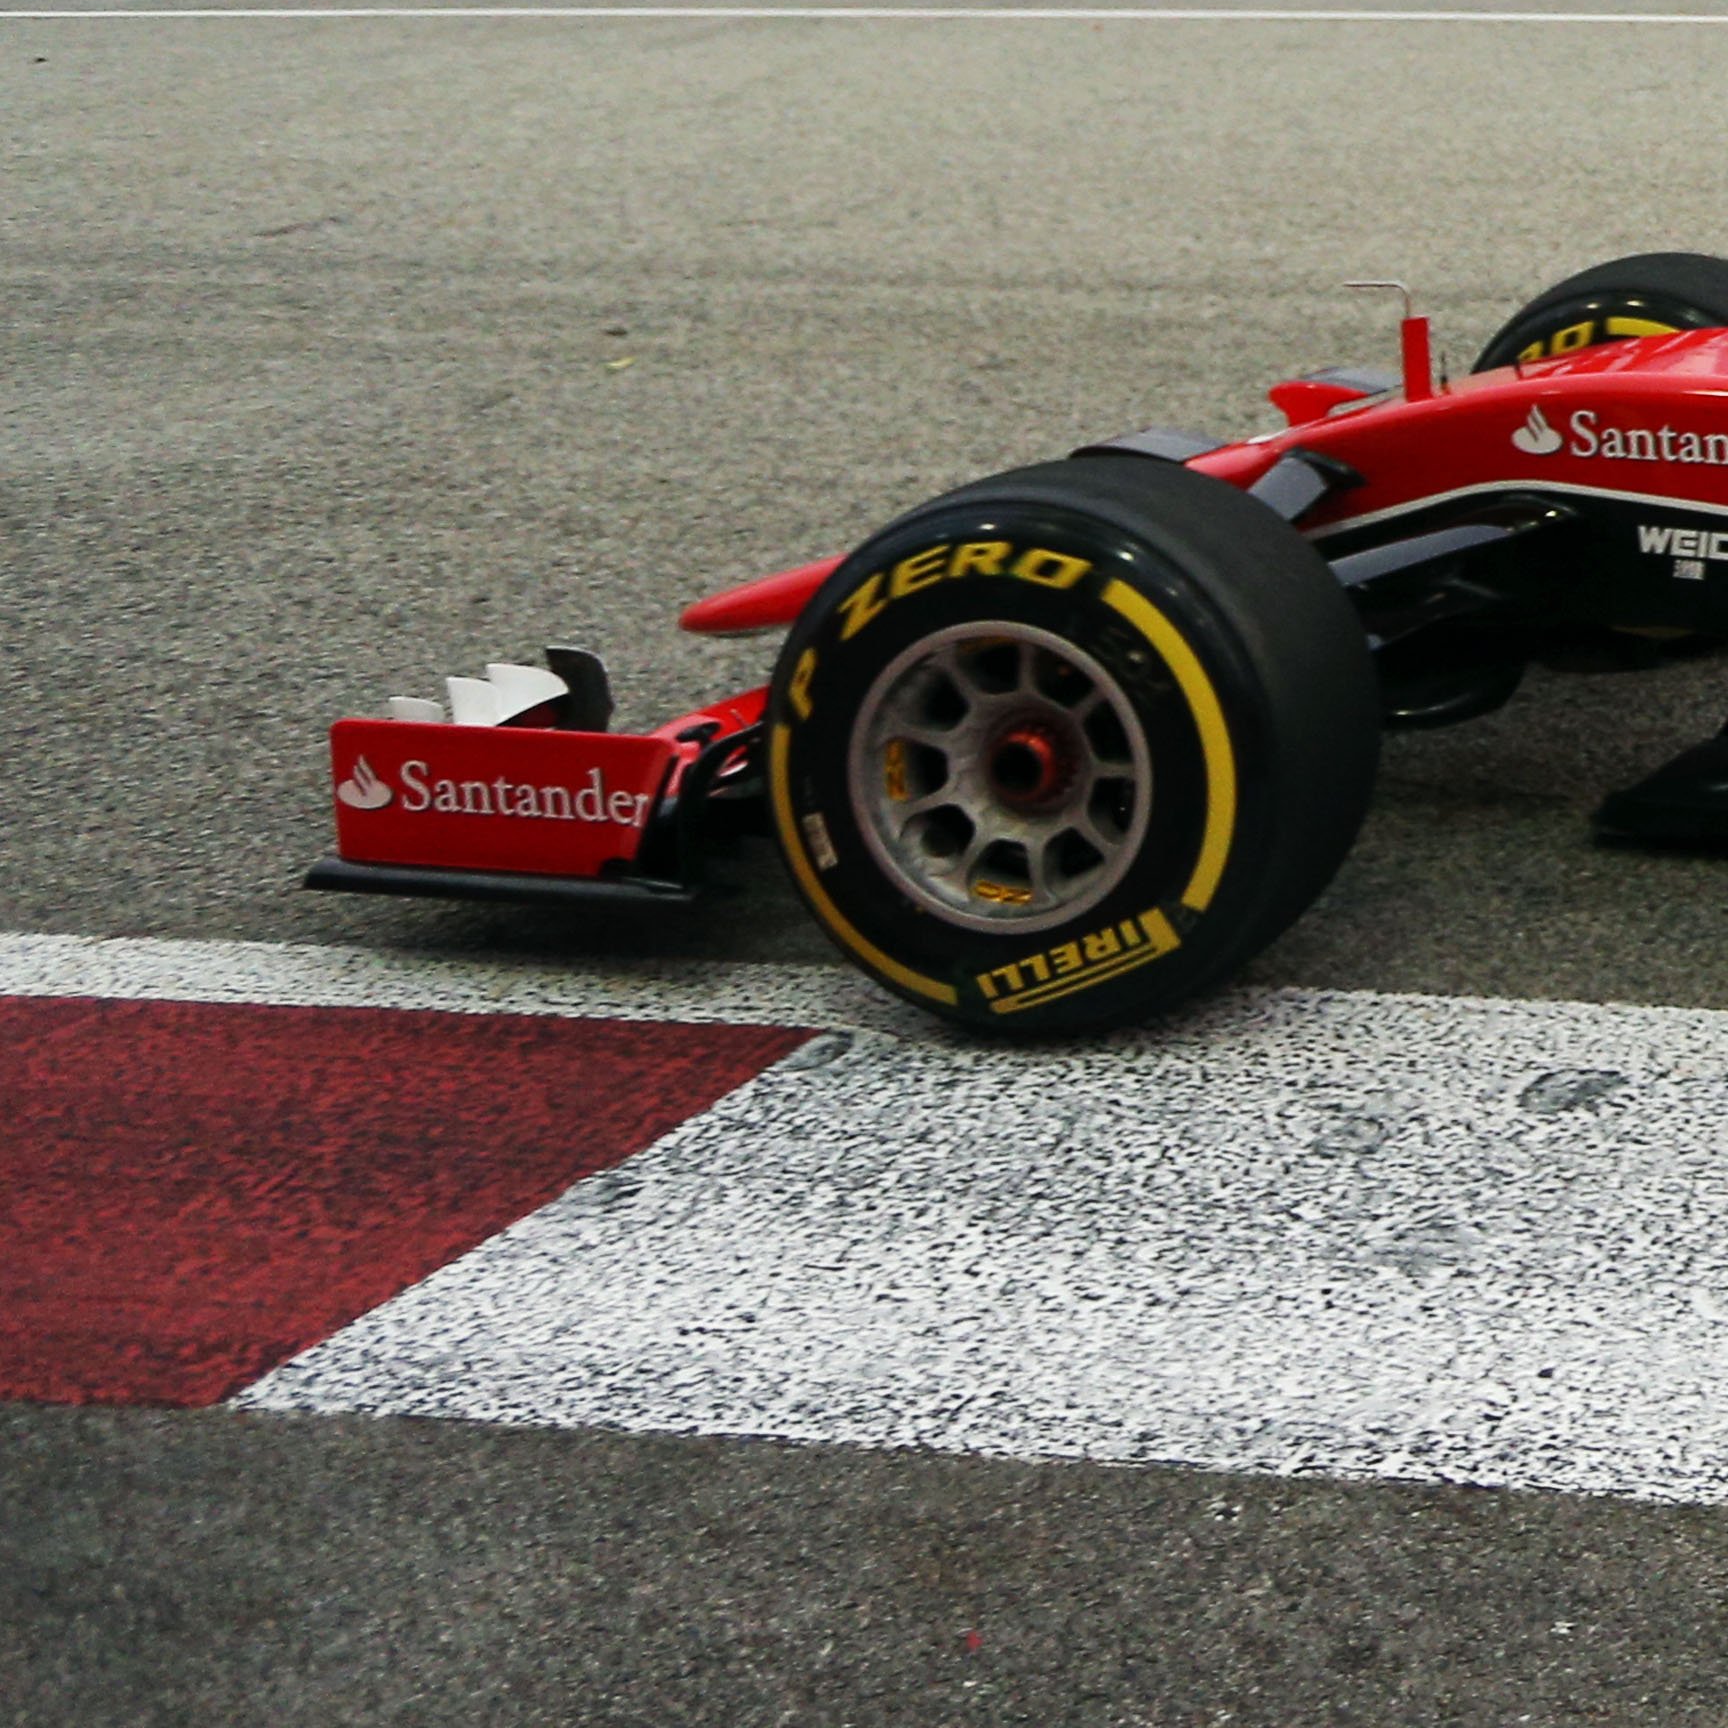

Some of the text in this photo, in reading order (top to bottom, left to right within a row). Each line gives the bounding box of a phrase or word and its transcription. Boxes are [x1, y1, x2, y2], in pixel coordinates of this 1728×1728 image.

[838, 541, 1093, 641] ZERO
[400, 759, 649, 828] Santander
[976, 907, 1181, 1015] PIRELLI
